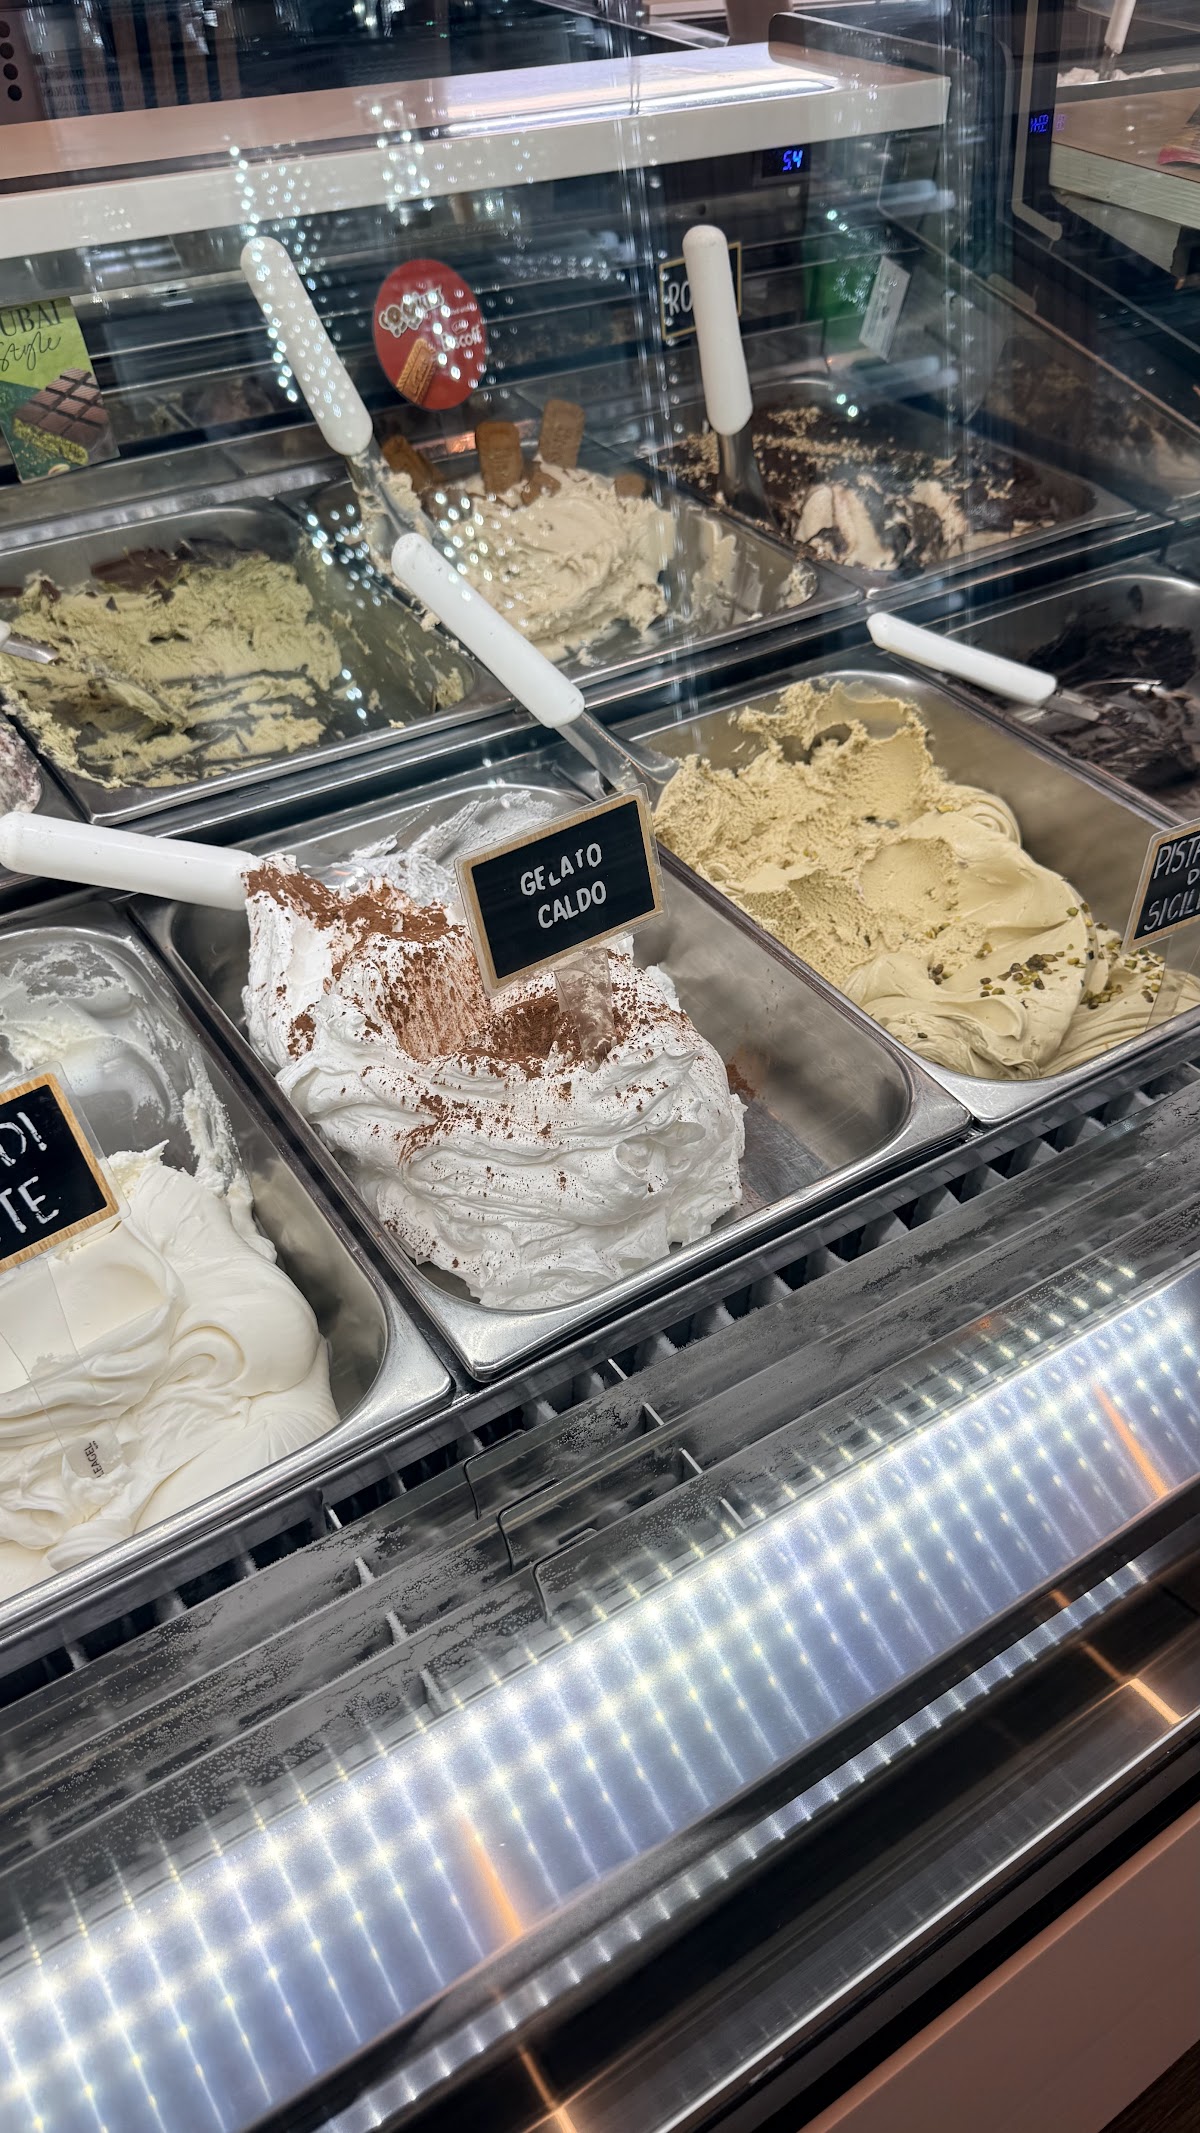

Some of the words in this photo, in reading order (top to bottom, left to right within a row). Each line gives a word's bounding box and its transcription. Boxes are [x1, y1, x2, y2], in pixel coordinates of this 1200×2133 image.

[379, 285, 445, 338] COOKIS
[668, 281, 693, 316] RO
[0, 301, 62, 337] UBAI
[441, 325, 482, 352] Bscoff
[520, 843, 603, 896] GELATO
[1187, 868, 1200, 885] D
[538, 881, 607, 929] CALDO
[0, 1176, 59, 1233] TE
[84, 1442, 105, 1479] LEAGEL
